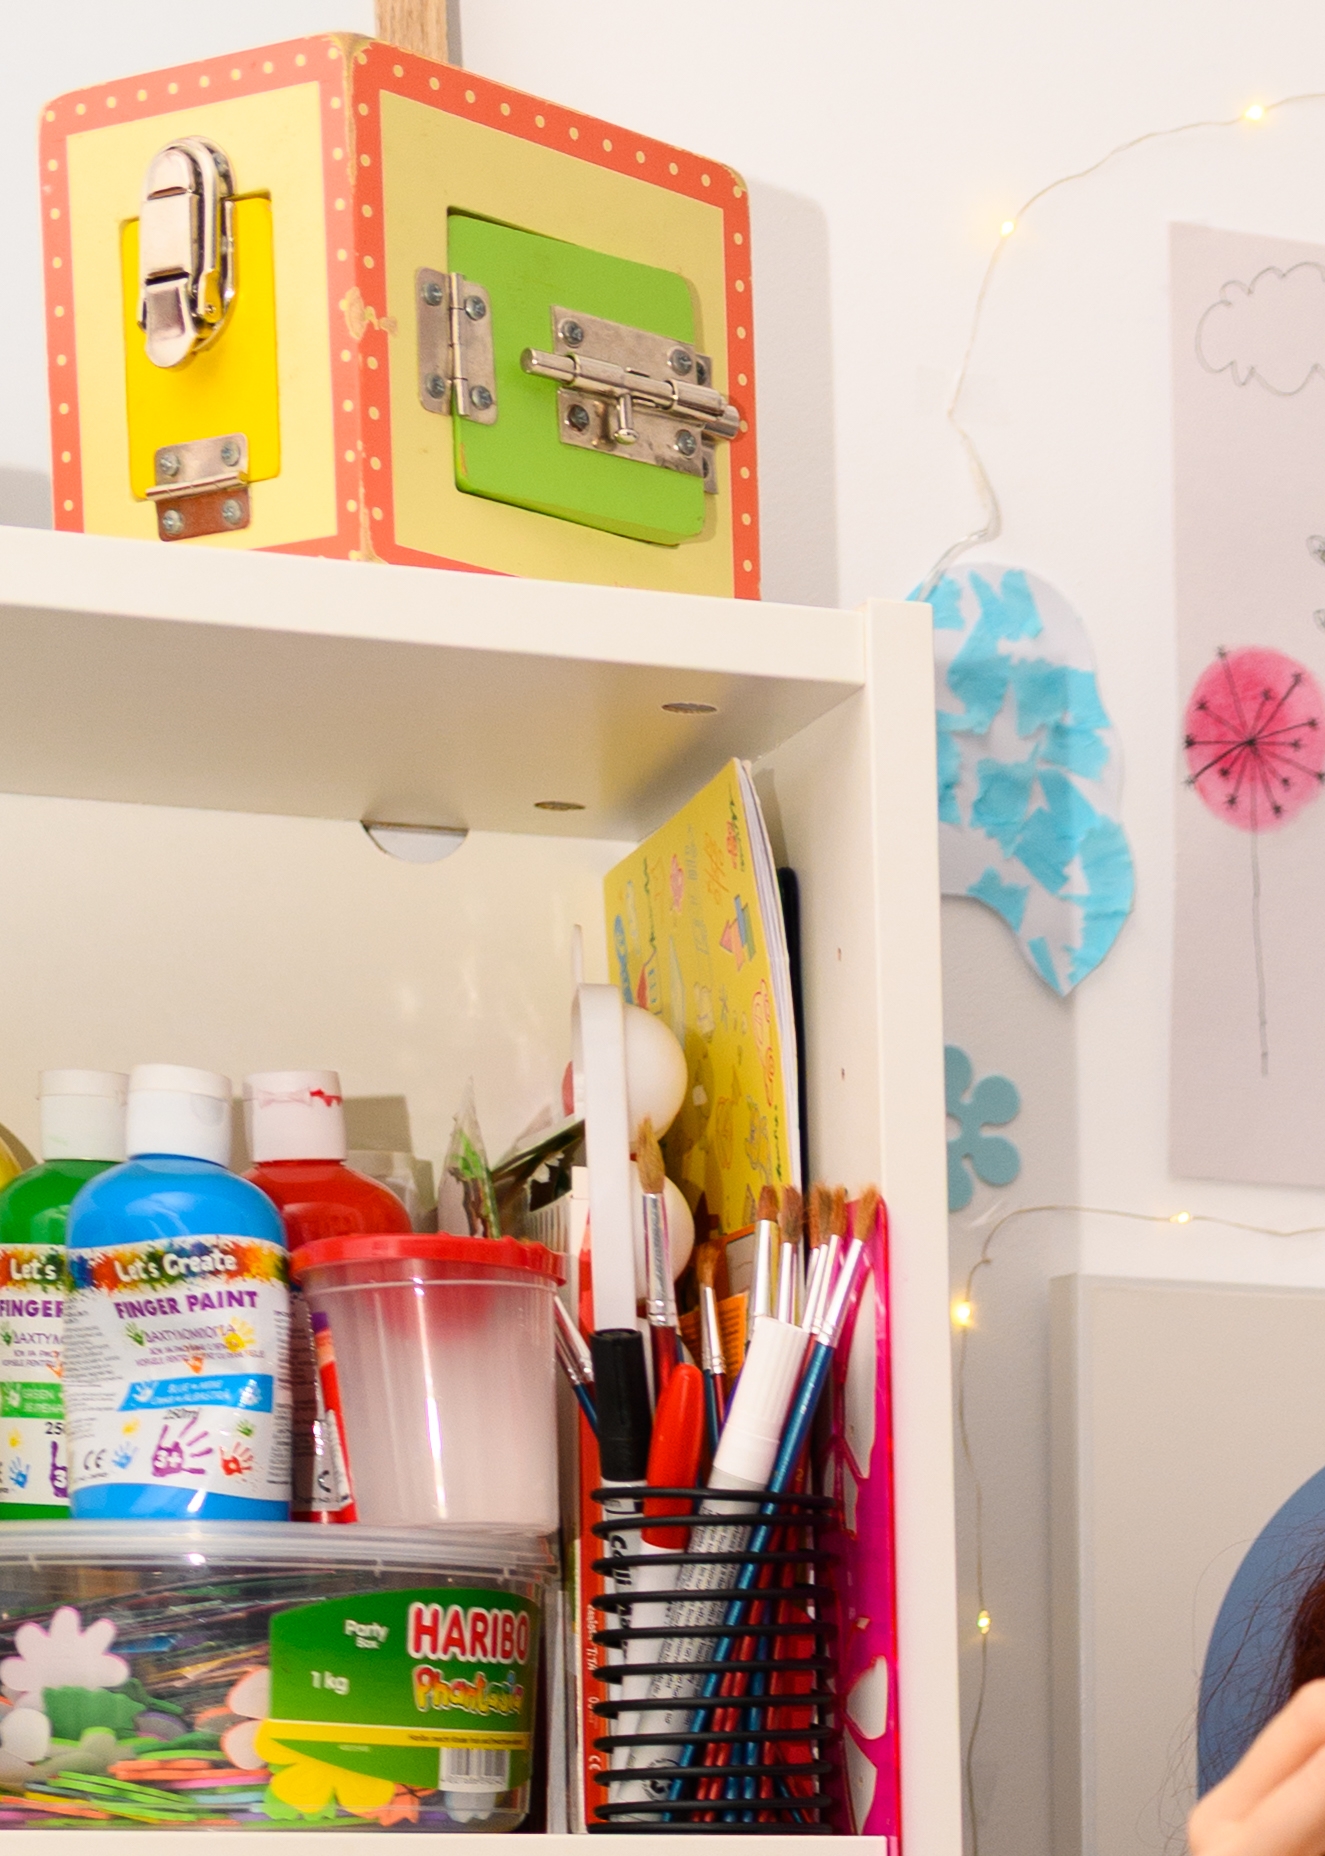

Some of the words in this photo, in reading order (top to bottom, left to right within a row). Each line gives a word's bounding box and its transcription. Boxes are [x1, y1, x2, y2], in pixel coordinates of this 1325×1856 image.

[113, 1259, 161, 1282] Let's
[162, 1251, 237, 1276] Create
[113, 1297, 181, 1319] FINGER
[185, 1290, 258, 1312] PAINT
[344, 1619, 390, 1643] Party
[408, 1602, 529, 1664] HARIBO
[323, 1672, 350, 1695] kg
